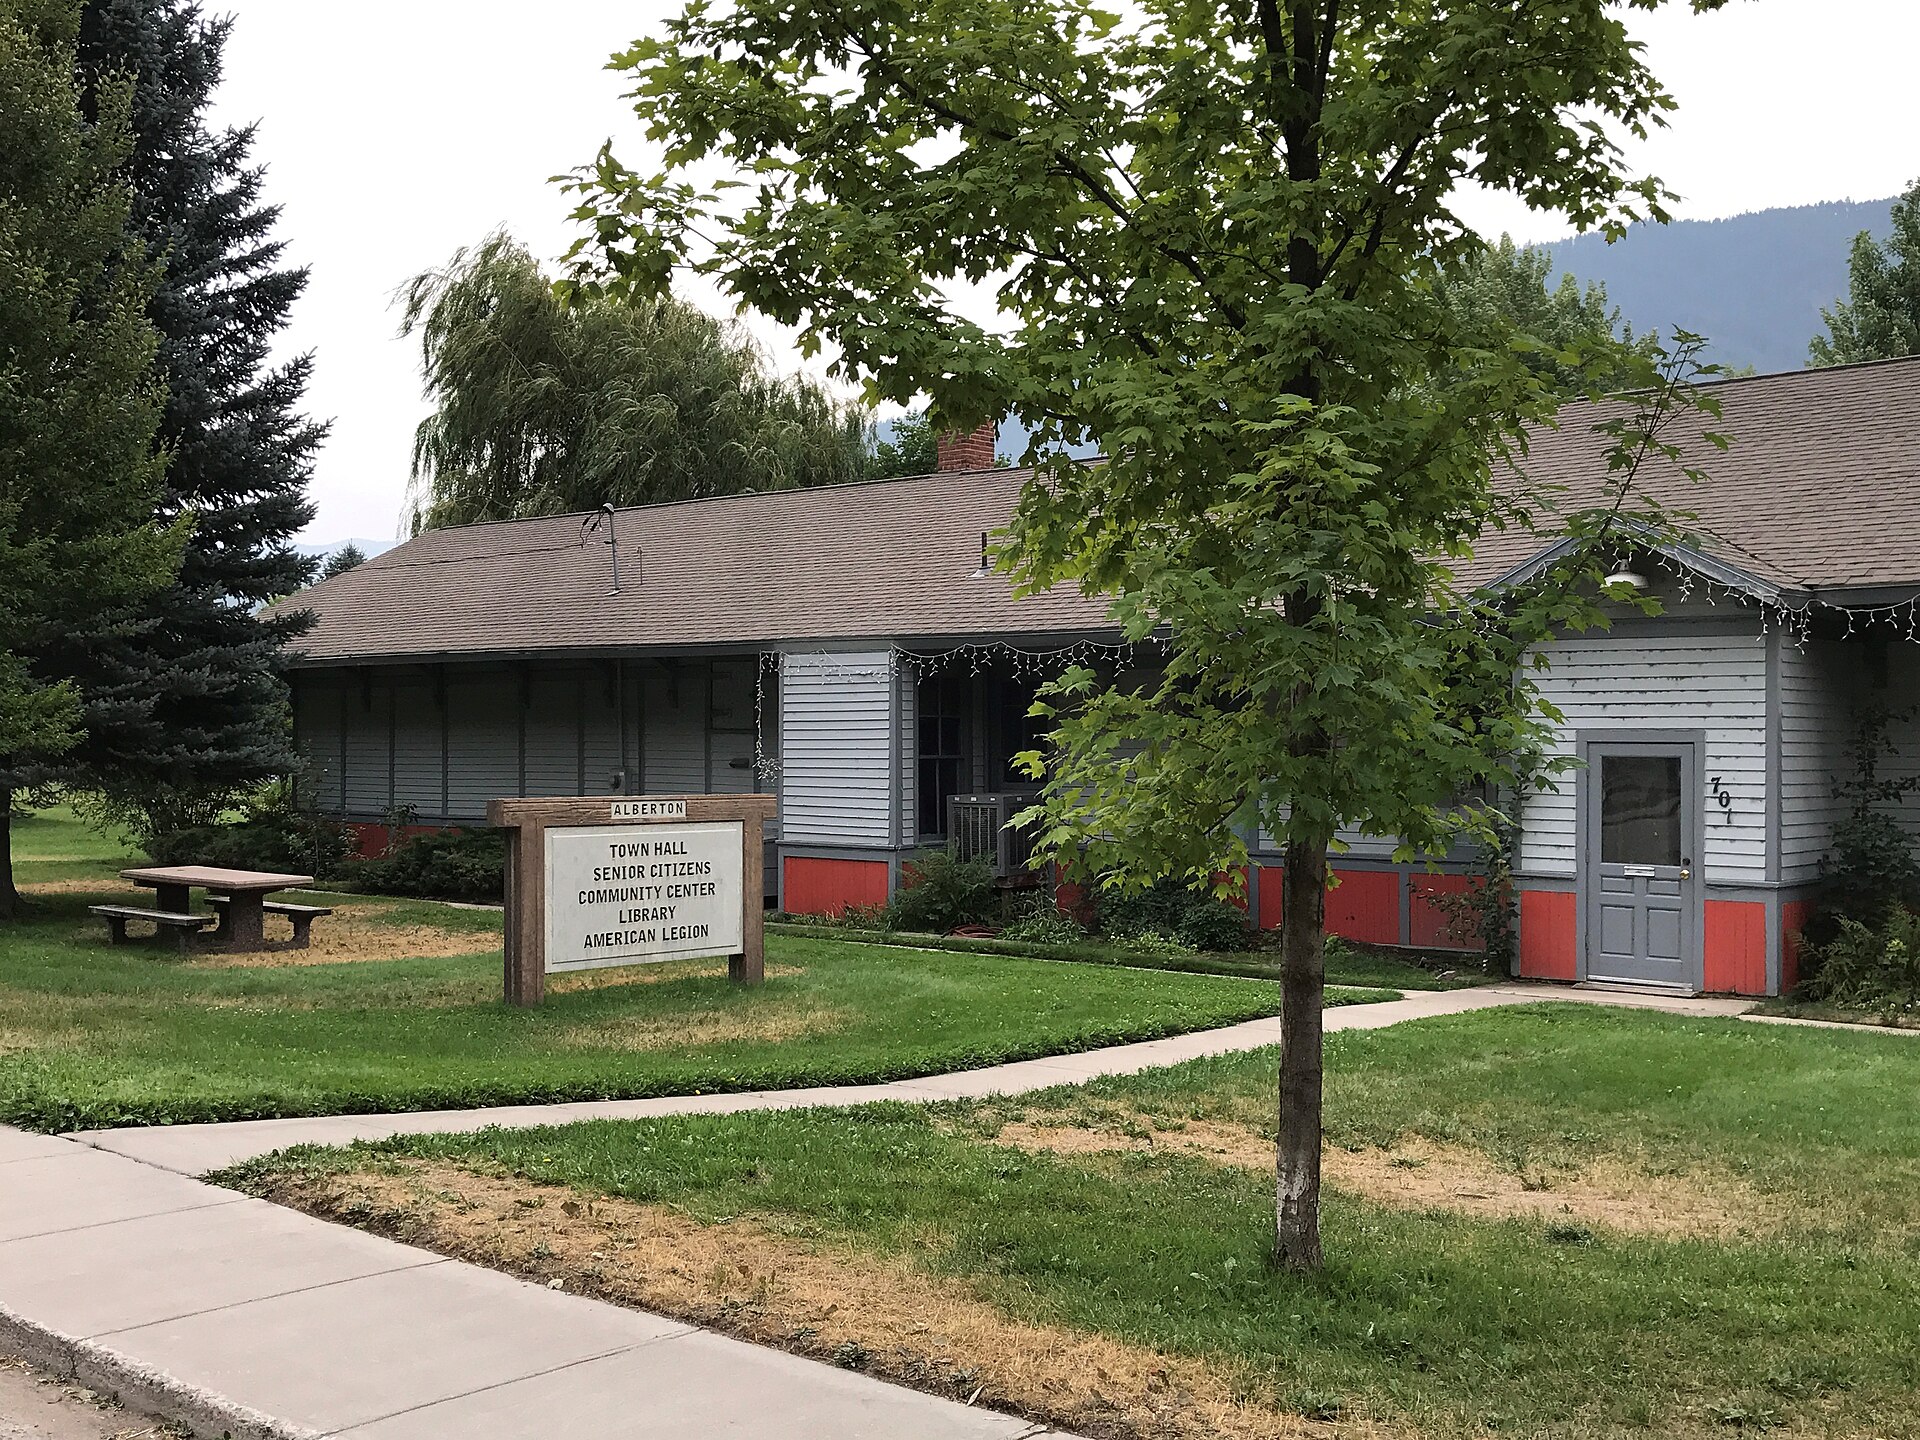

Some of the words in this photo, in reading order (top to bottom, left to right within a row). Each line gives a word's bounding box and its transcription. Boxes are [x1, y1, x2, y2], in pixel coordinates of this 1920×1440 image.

[613, 802, 684, 816] ALBERTON
[1710, 776, 1732, 824] 701
[610, 843, 649, 858] TOWN
[654, 841, 688, 855] HALL
[593, 866, 645, 881] SENIOR
[650, 861, 711, 877] CITIZENS
[578, 885, 662, 905] COMMUNITY
[666, 882, 716, 899] CENTER
[619, 905, 676, 924] LIBRARY
[583, 928, 656, 949] AMERICAN
[662, 924, 709, 941] LEGION
